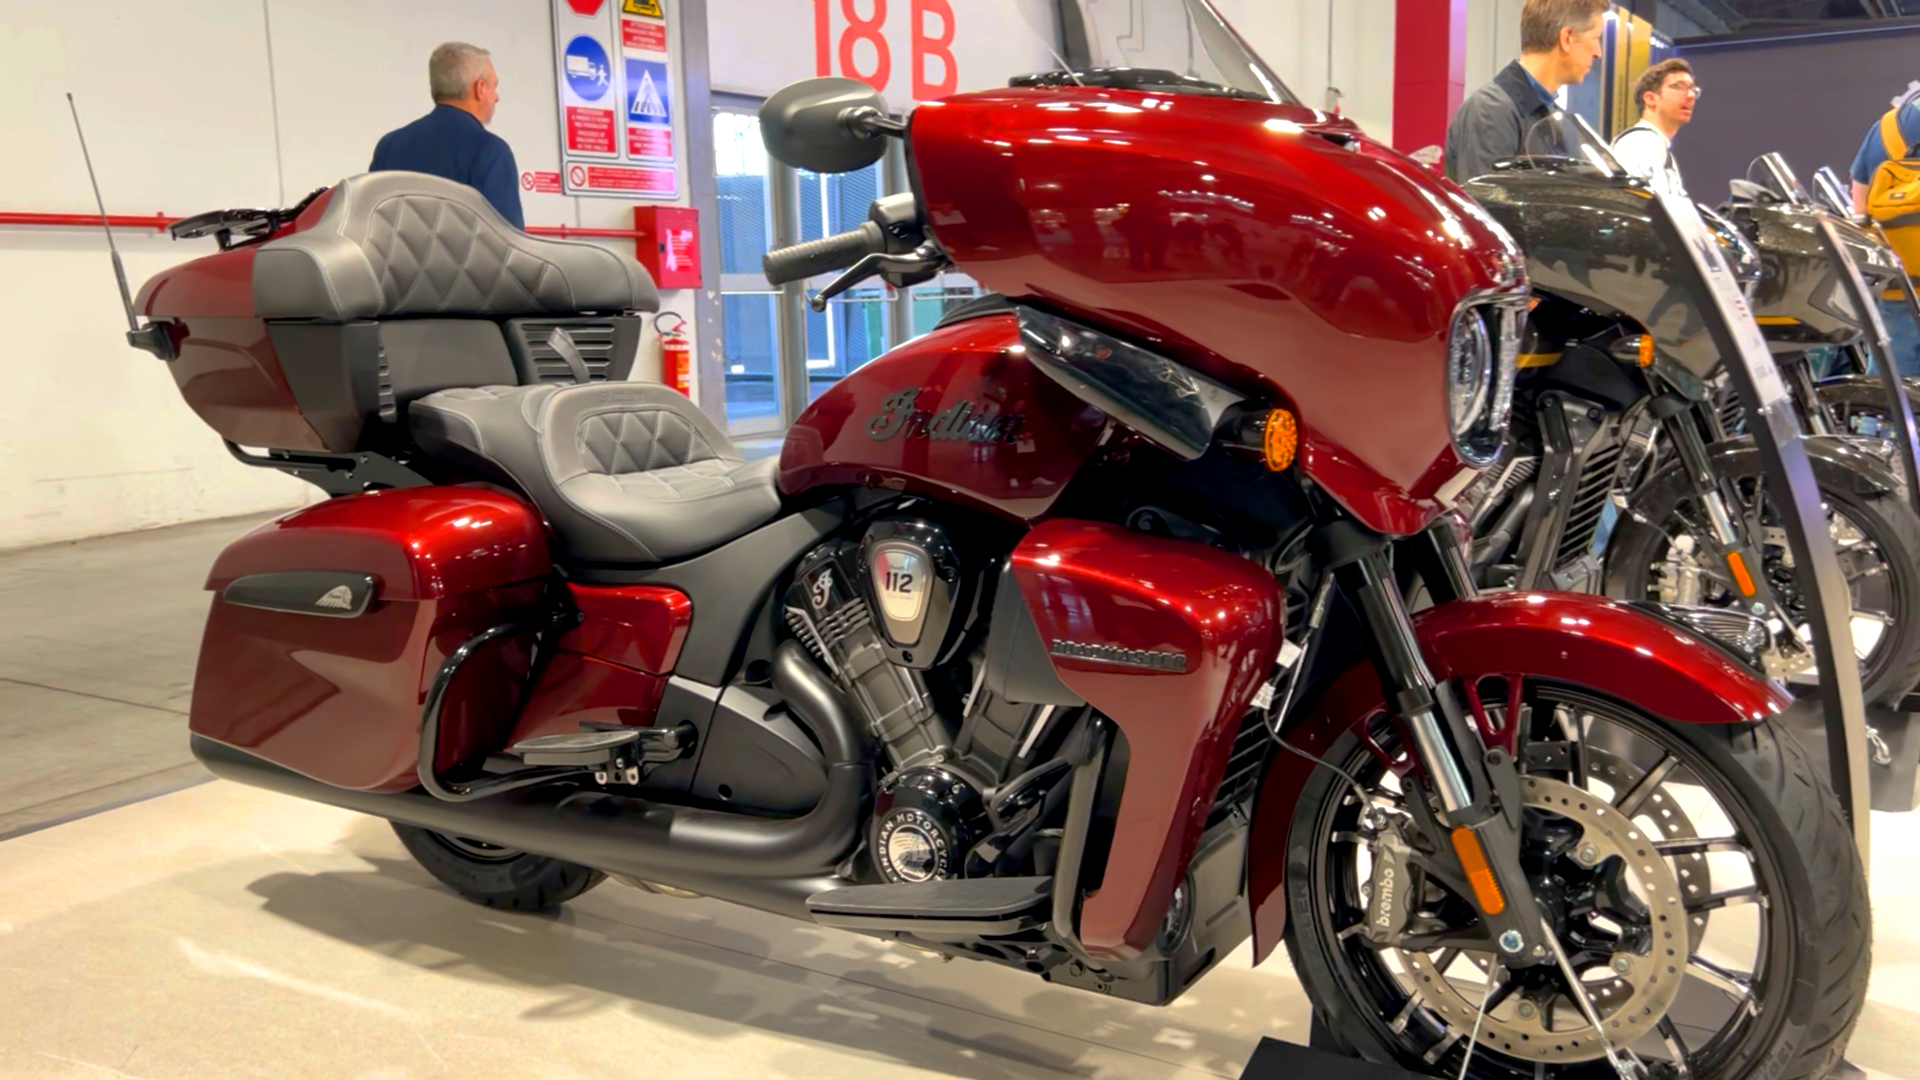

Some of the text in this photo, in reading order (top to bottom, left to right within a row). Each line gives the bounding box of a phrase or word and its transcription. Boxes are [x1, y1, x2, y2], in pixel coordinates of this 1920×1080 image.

[910, 0, 958, 101] B
[886, 571, 913, 593] 112
[879, 820, 894, 873] INDIAN
